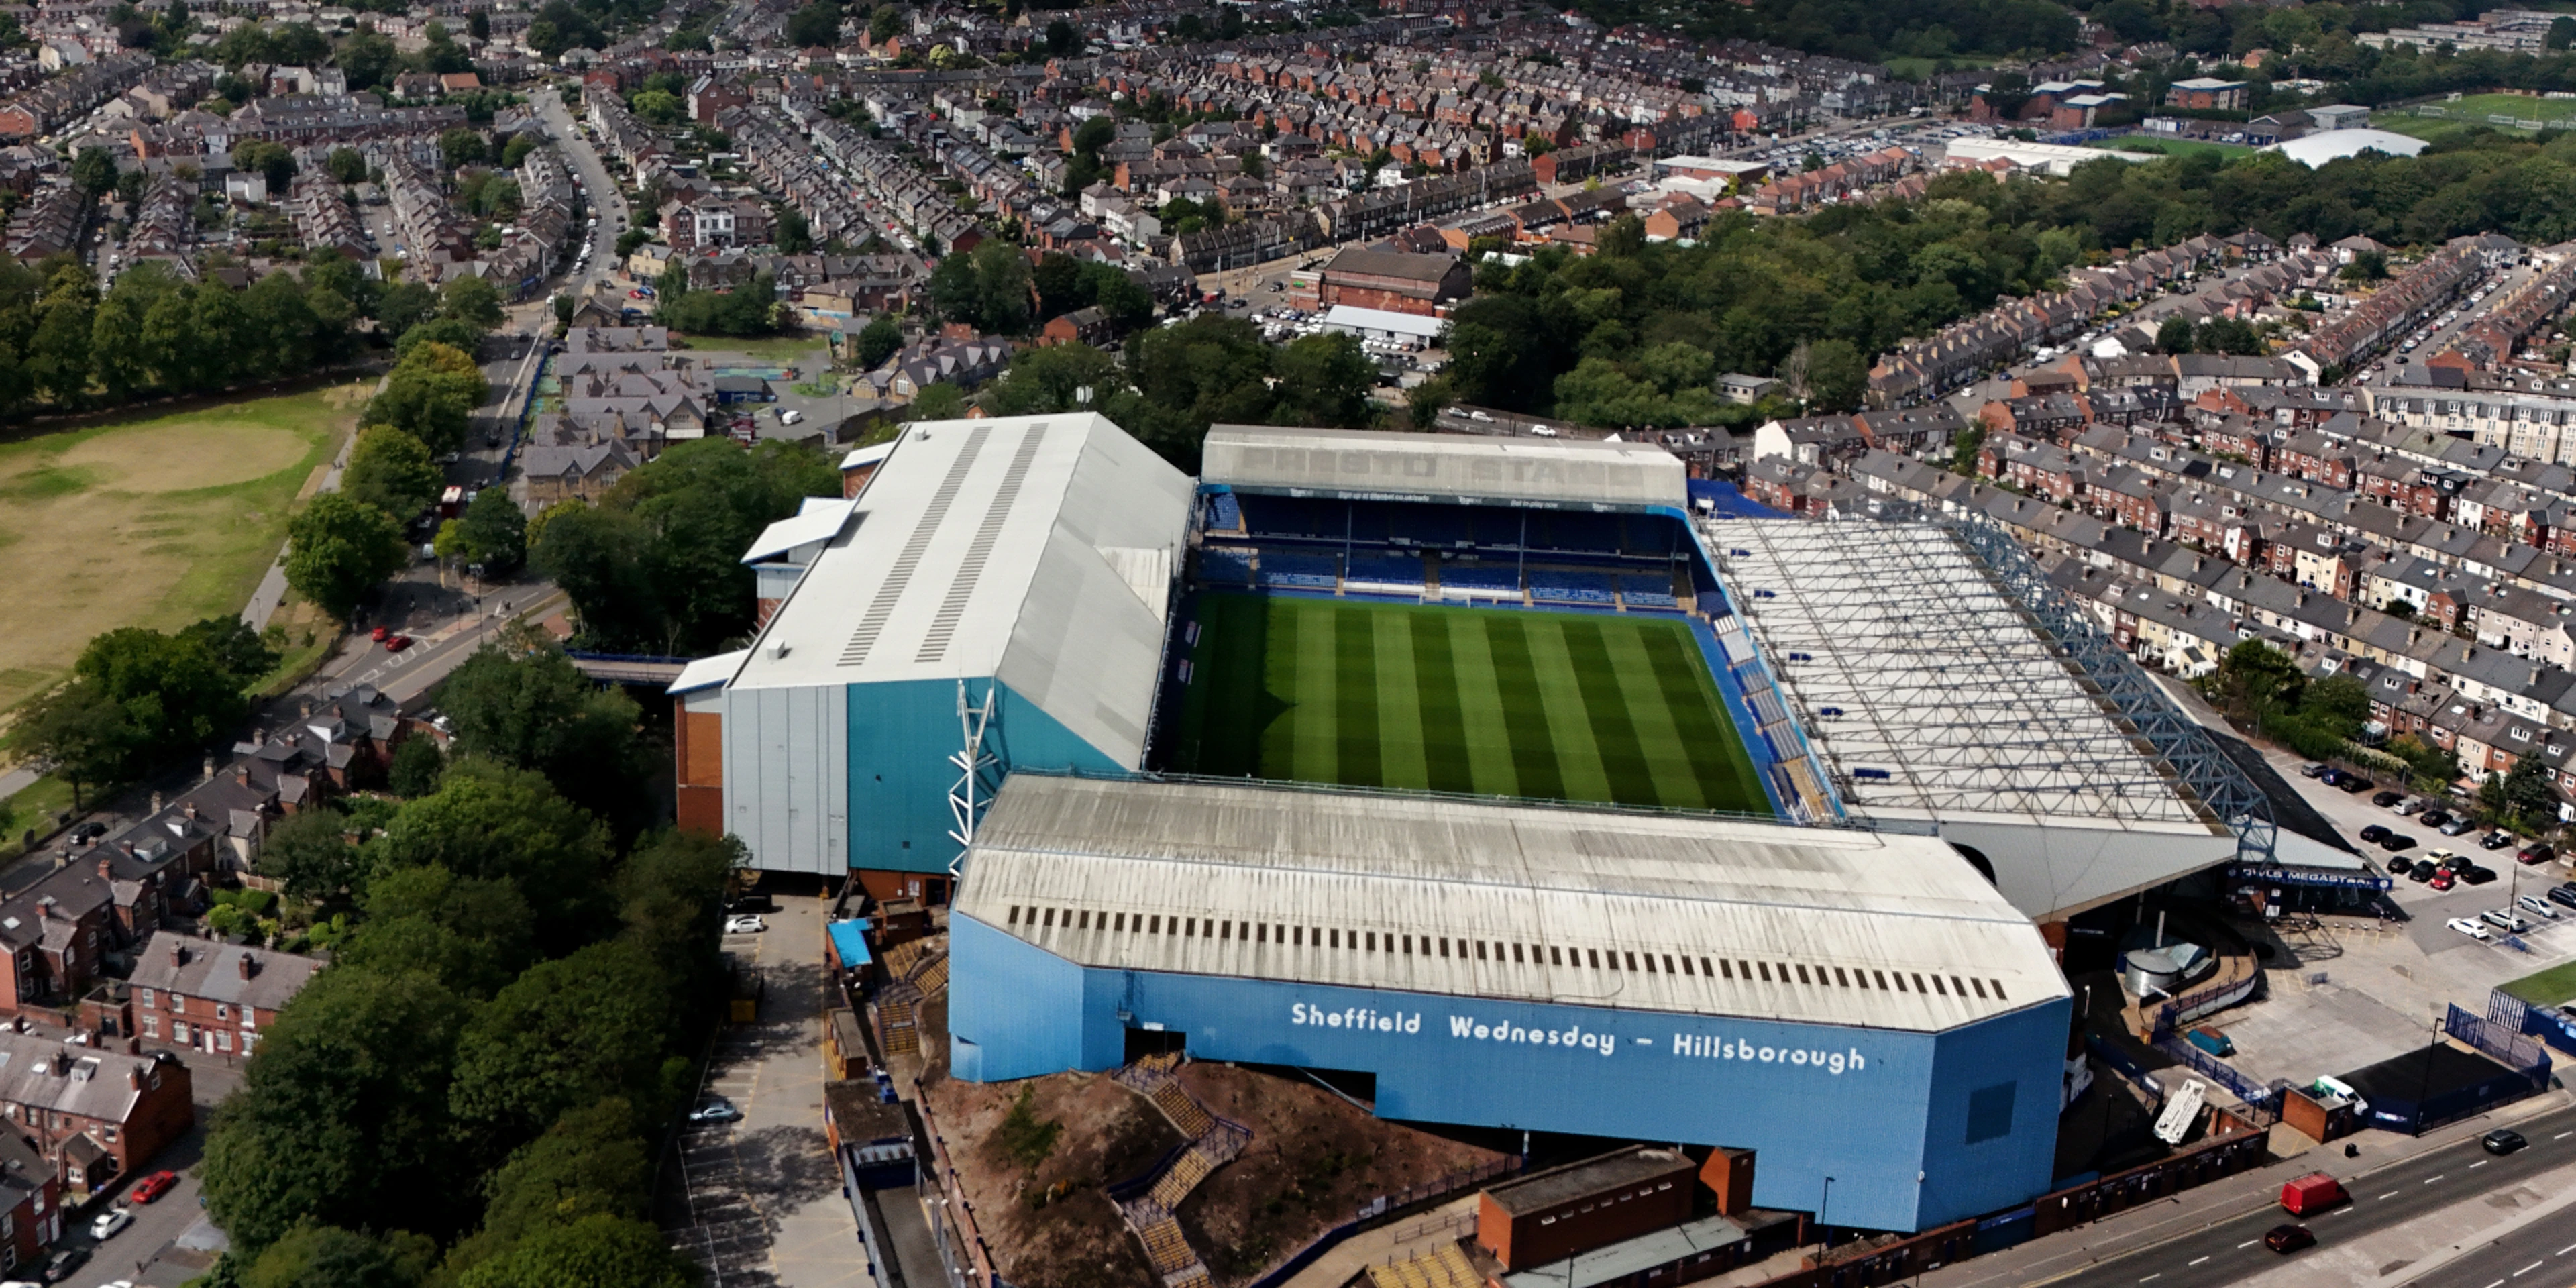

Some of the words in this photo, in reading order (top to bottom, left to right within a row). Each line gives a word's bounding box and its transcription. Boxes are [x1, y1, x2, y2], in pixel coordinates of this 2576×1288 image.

[1291, 1002, 1421, 1034] Sheffield
[1449, 1015, 1615, 1057] Wednesday
[1673, 1032, 1866, 1075] Hillsborough
